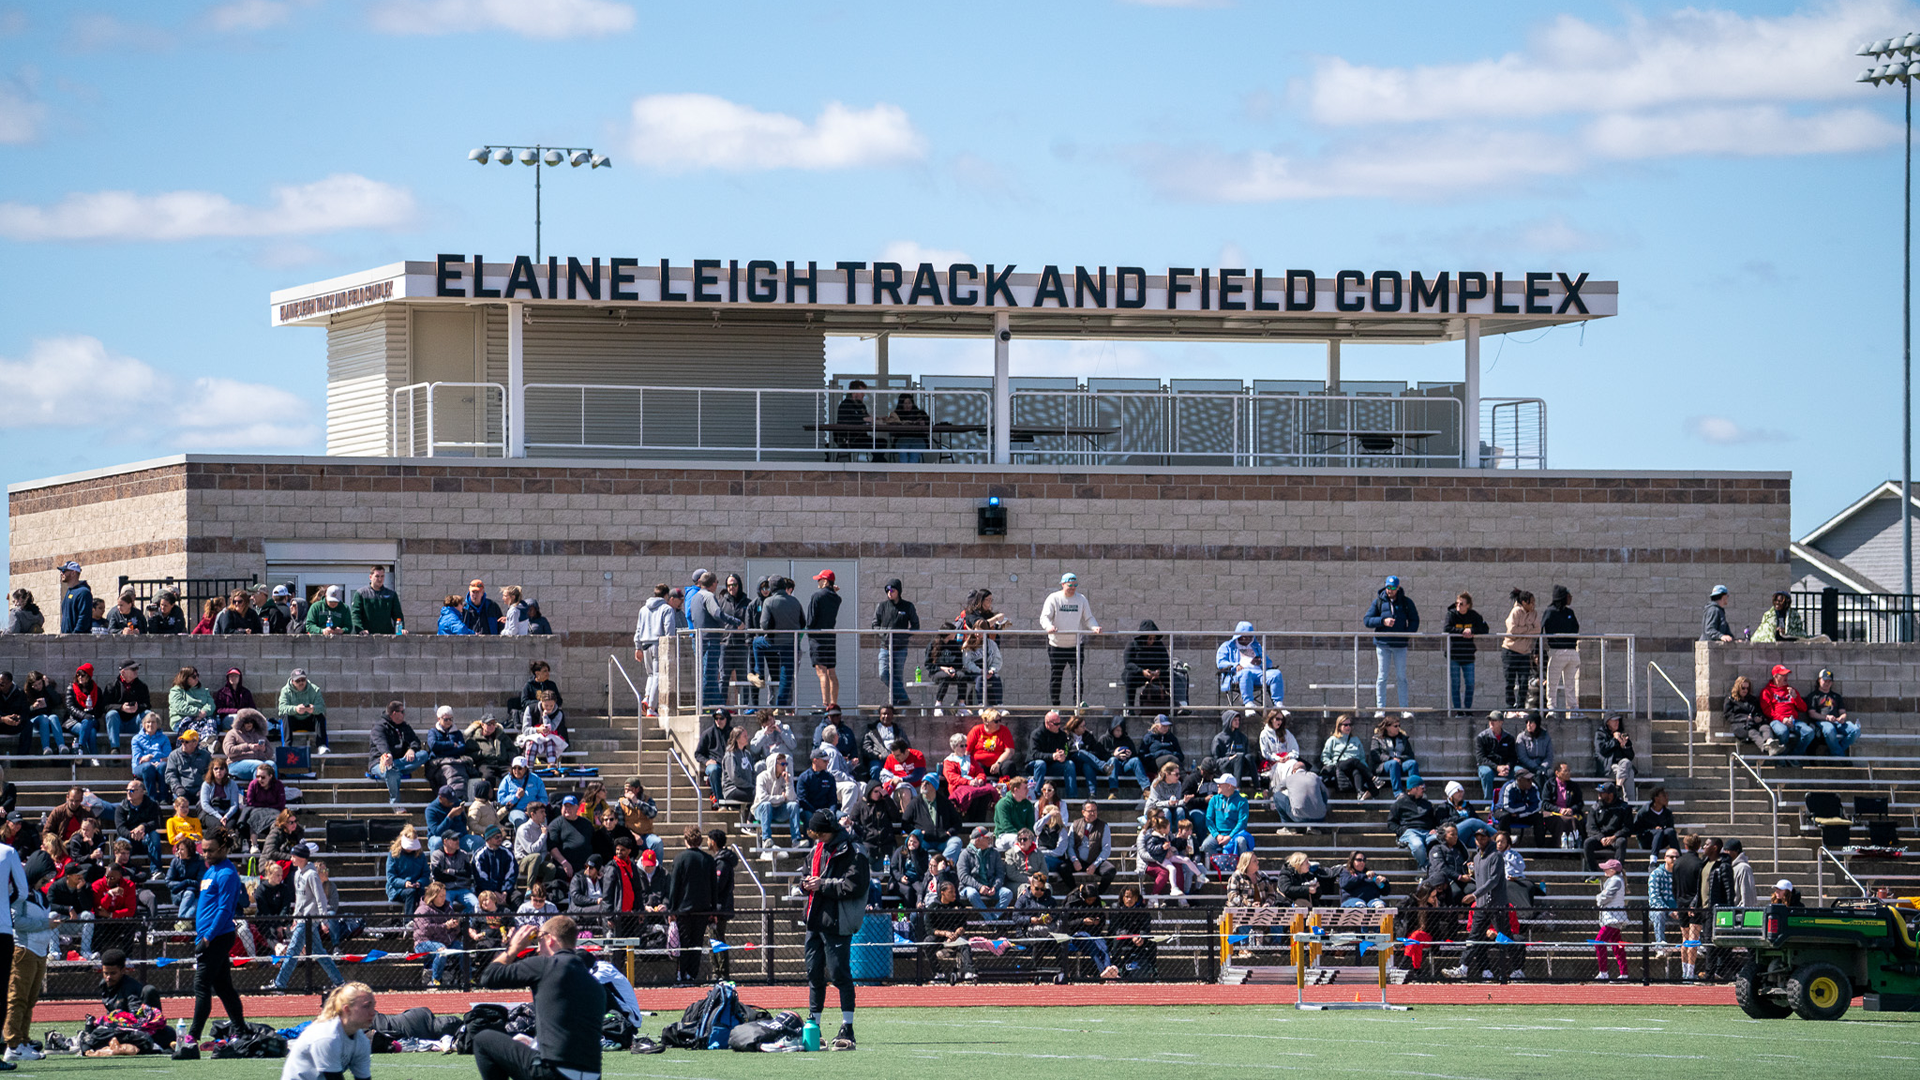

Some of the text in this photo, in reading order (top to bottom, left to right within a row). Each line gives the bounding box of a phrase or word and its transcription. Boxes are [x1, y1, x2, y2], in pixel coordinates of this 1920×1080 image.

[436, 253, 1590, 314] ELAINE LEIGH TRACK AND FIELD COMPLEX
